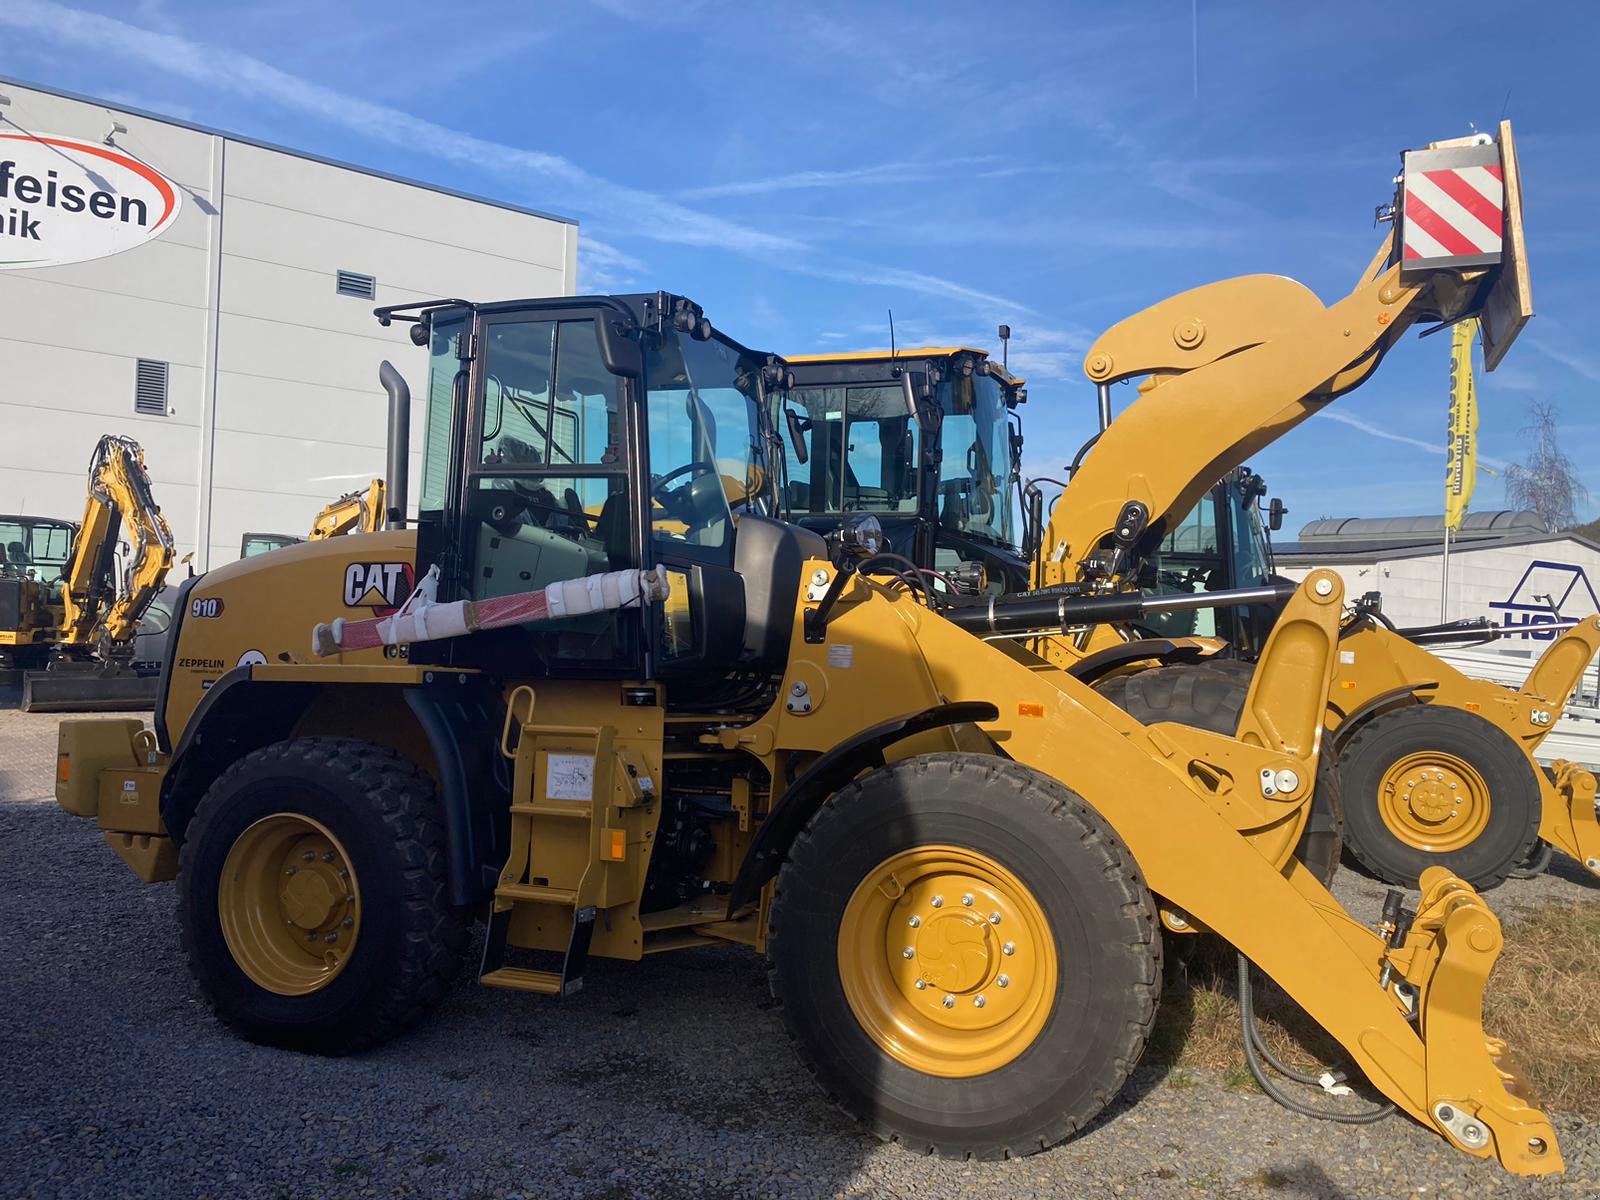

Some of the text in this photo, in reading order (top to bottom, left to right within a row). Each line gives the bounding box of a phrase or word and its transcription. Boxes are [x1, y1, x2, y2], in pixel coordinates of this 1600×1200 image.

[0, 208, 41, 240] ik
[346, 563, 403, 606] CAT
[192, 598, 217, 618] 910
[178, 658, 225, 668] ZEPPELIN
